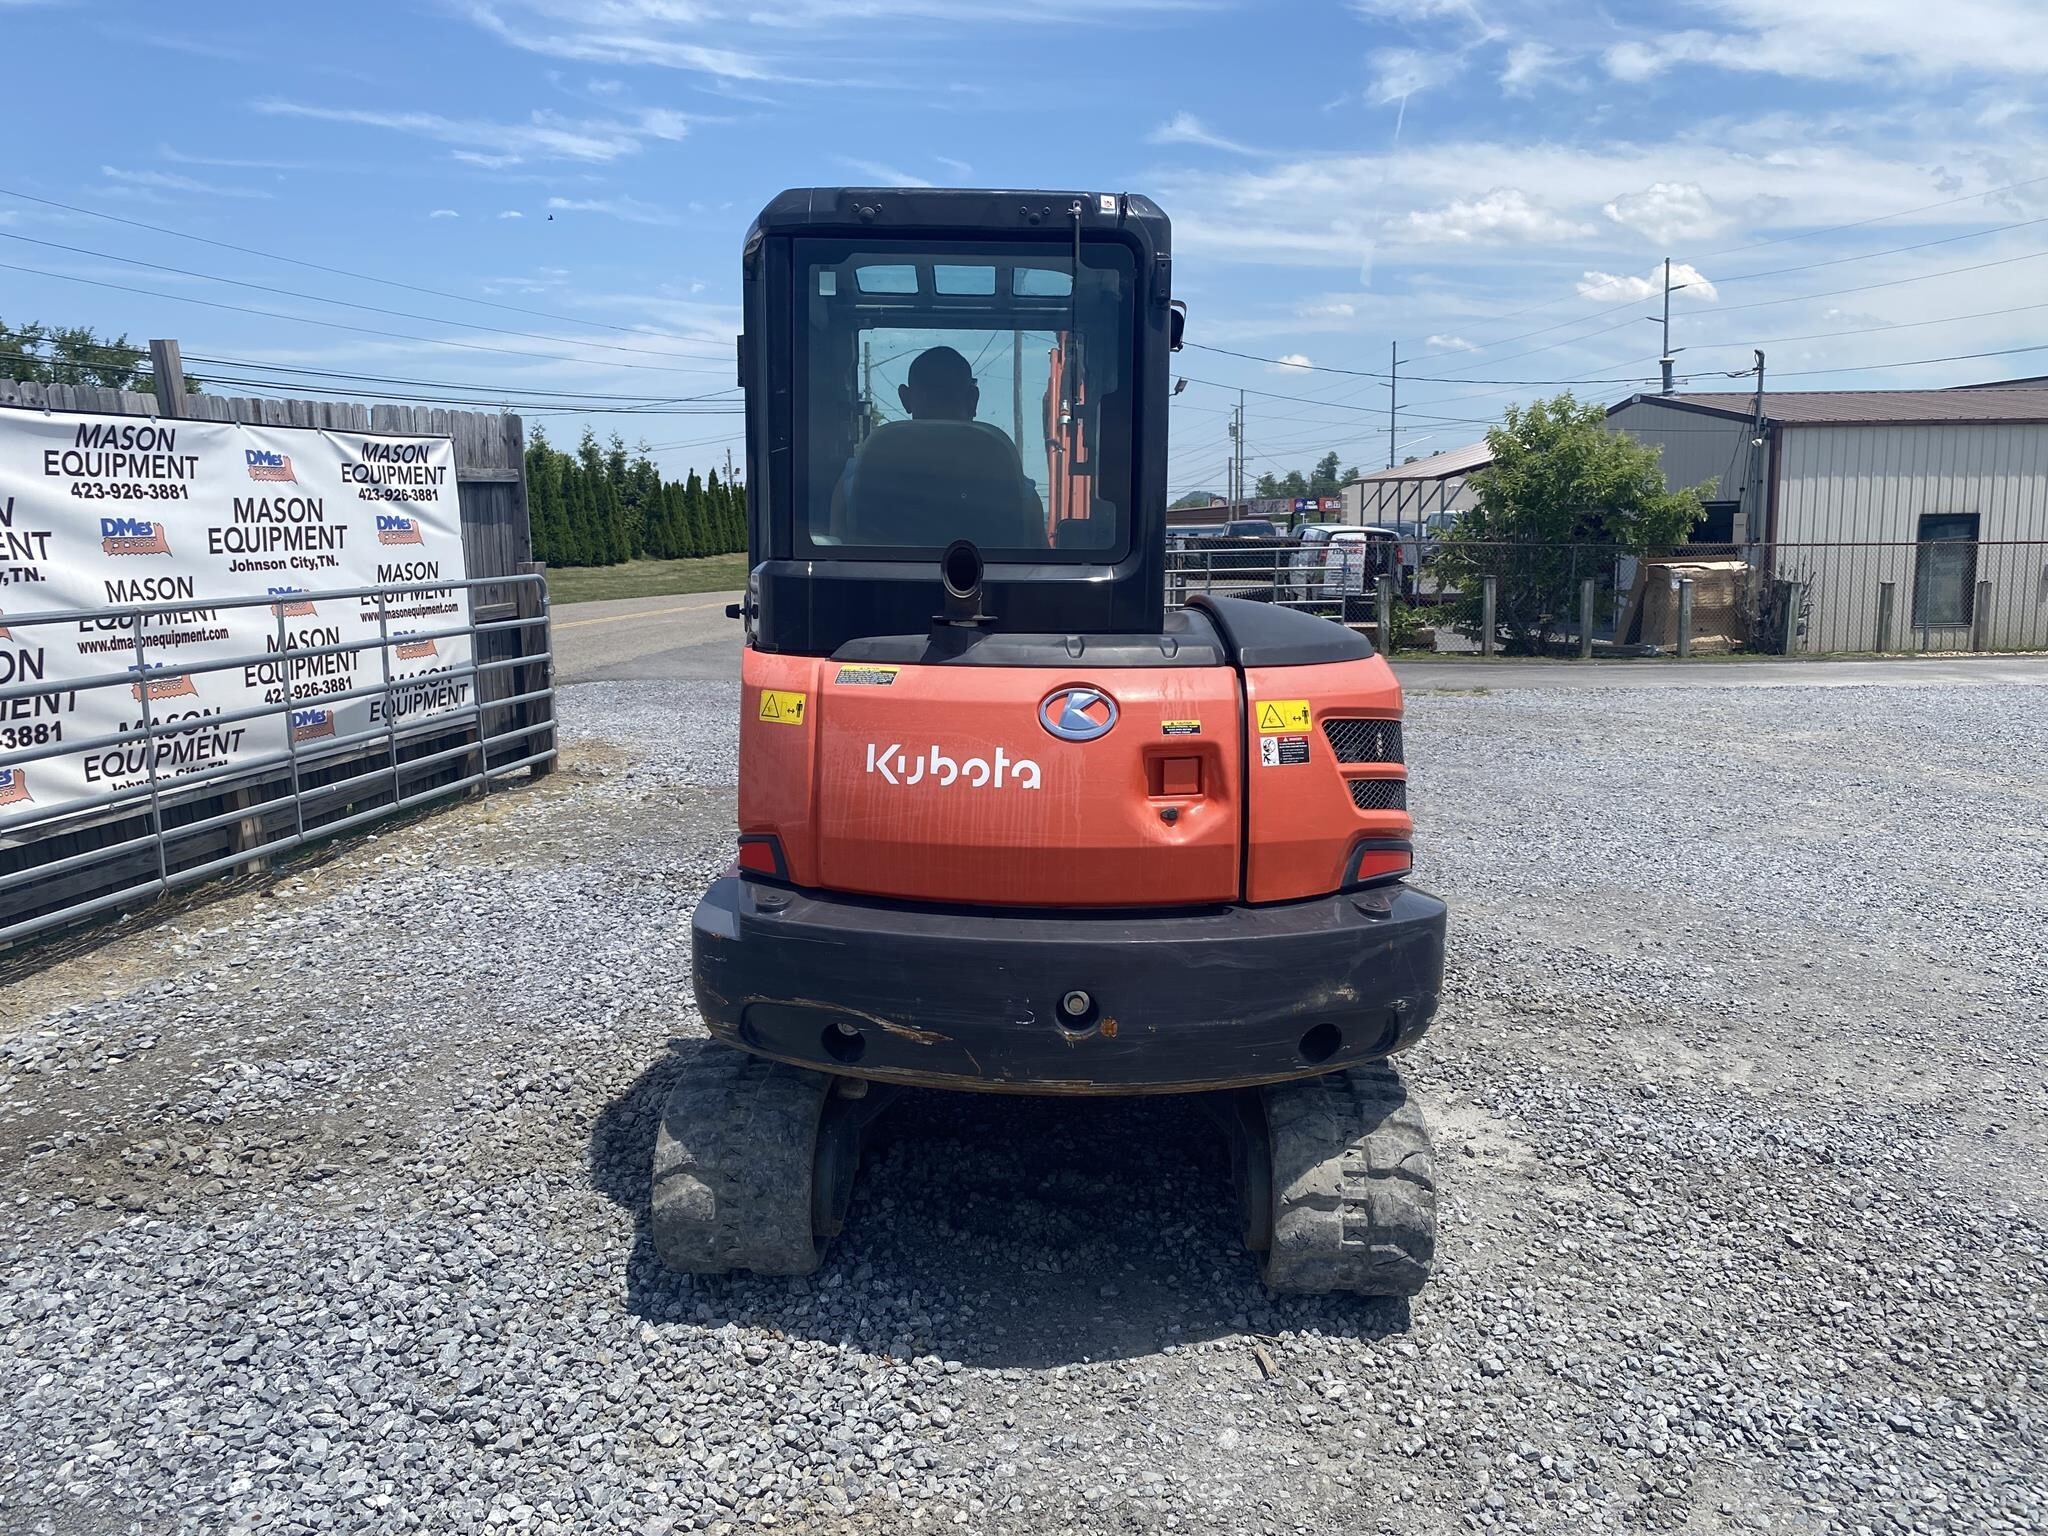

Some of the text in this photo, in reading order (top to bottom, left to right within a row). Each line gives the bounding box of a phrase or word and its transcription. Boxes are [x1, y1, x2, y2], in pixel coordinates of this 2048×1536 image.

[75, 423, 176, 452] MASON
[44, 450, 199, 480] EQUIPMENT
[361, 442, 429, 464] MASON
[341, 463, 447, 486] EQUIPMENT
[71, 482, 189, 500] 423-926-3881
[358, 488, 439, 502] 423-926-3881
[233, 497, 324, 524] MASON
[207, 525, 348, 555] EQUIPMENT
[228, 555, 339, 573] Johnson City,TN.
[376, 561, 439, 583] MASON
[104, 576, 194, 603] MASON
[360, 602, 459, 623] wwwmasonequipment.com
[77, 627, 230, 655] www.dmaonequipment.com
[264, 676, 353, 704] 42-926-3881
[84, 728, 246, 783] EQUPMENT
[866, 743, 1041, 790] Kubota
